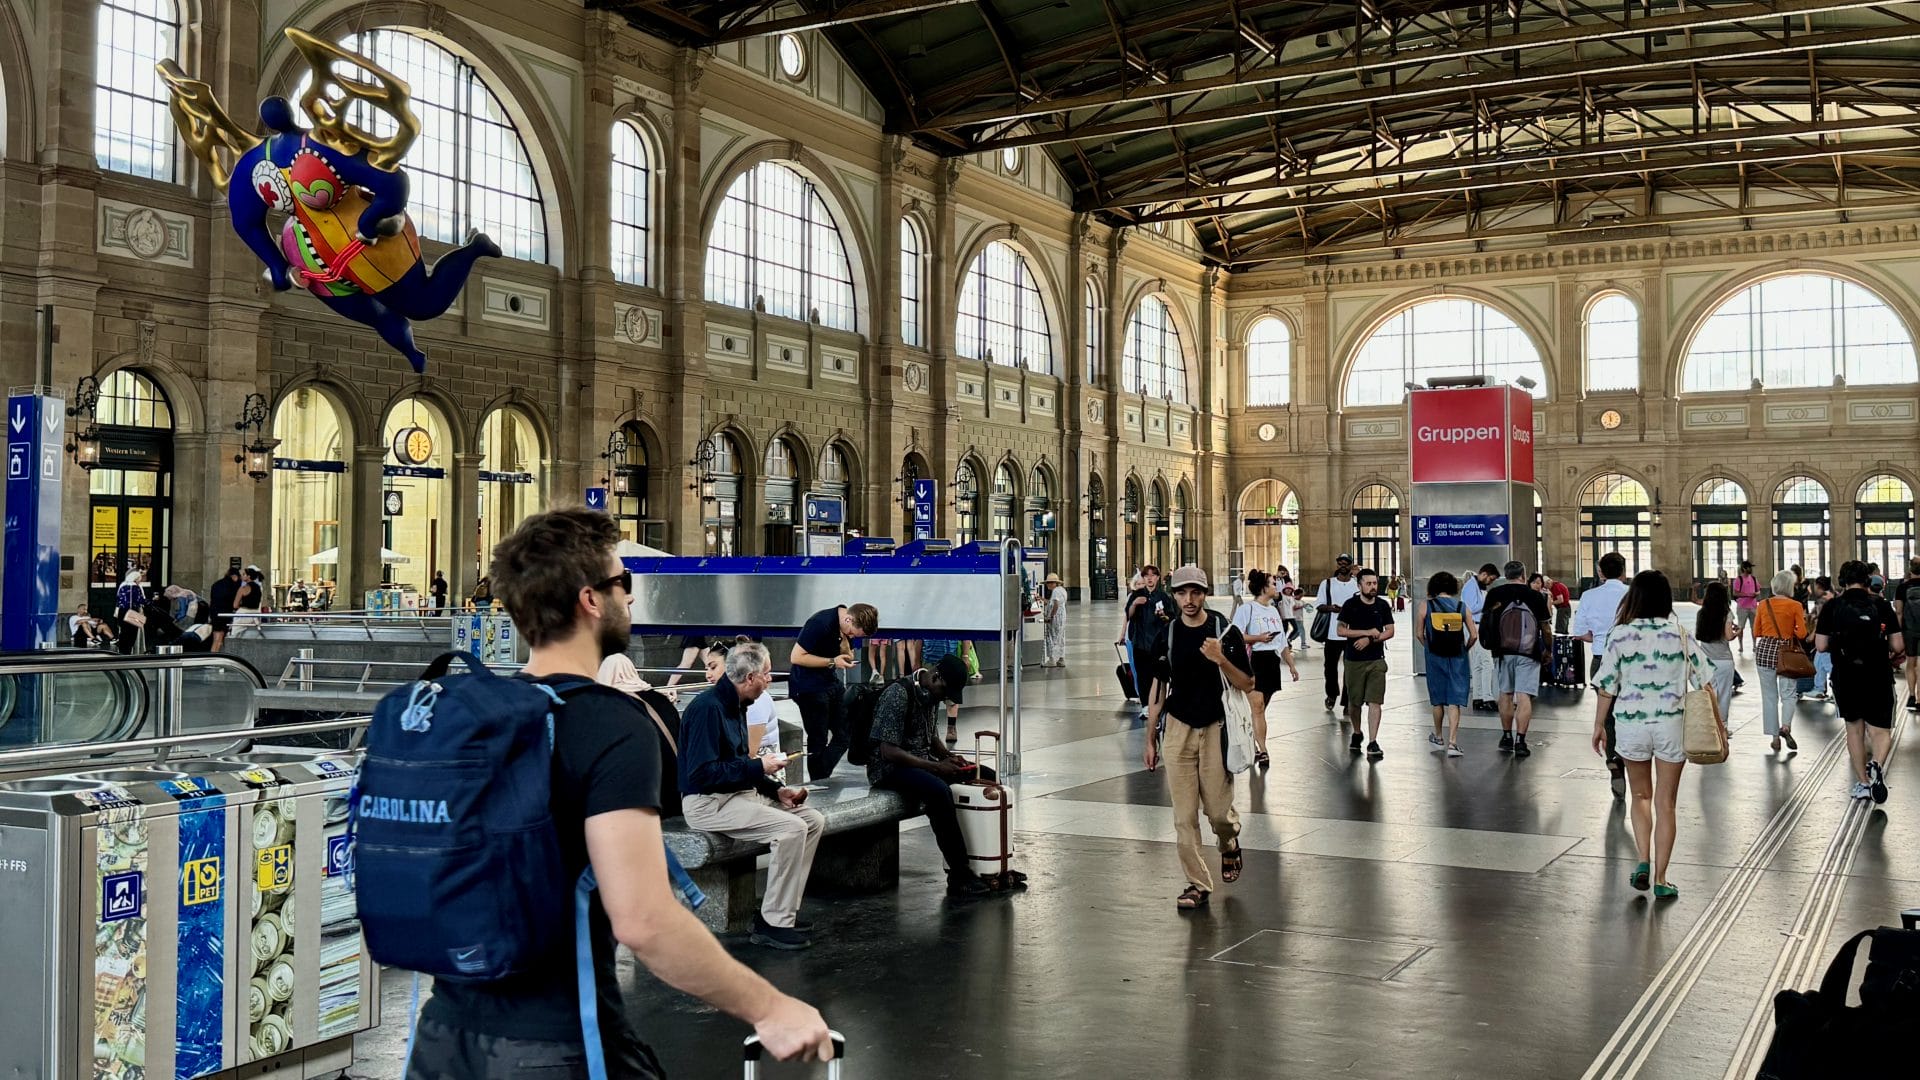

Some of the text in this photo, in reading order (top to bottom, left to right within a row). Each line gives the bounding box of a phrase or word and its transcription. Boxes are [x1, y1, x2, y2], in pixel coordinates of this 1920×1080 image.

[1417, 426, 1500, 443] Gruppen
[1512, 424, 1530, 444] Groups
[105, 446, 128, 454] Western
[188, 790, 207, 798] PET
[360, 794, 452, 824] CAROLINA
[10, 859, 27, 872] FFS
[199, 887, 217, 899] PET
